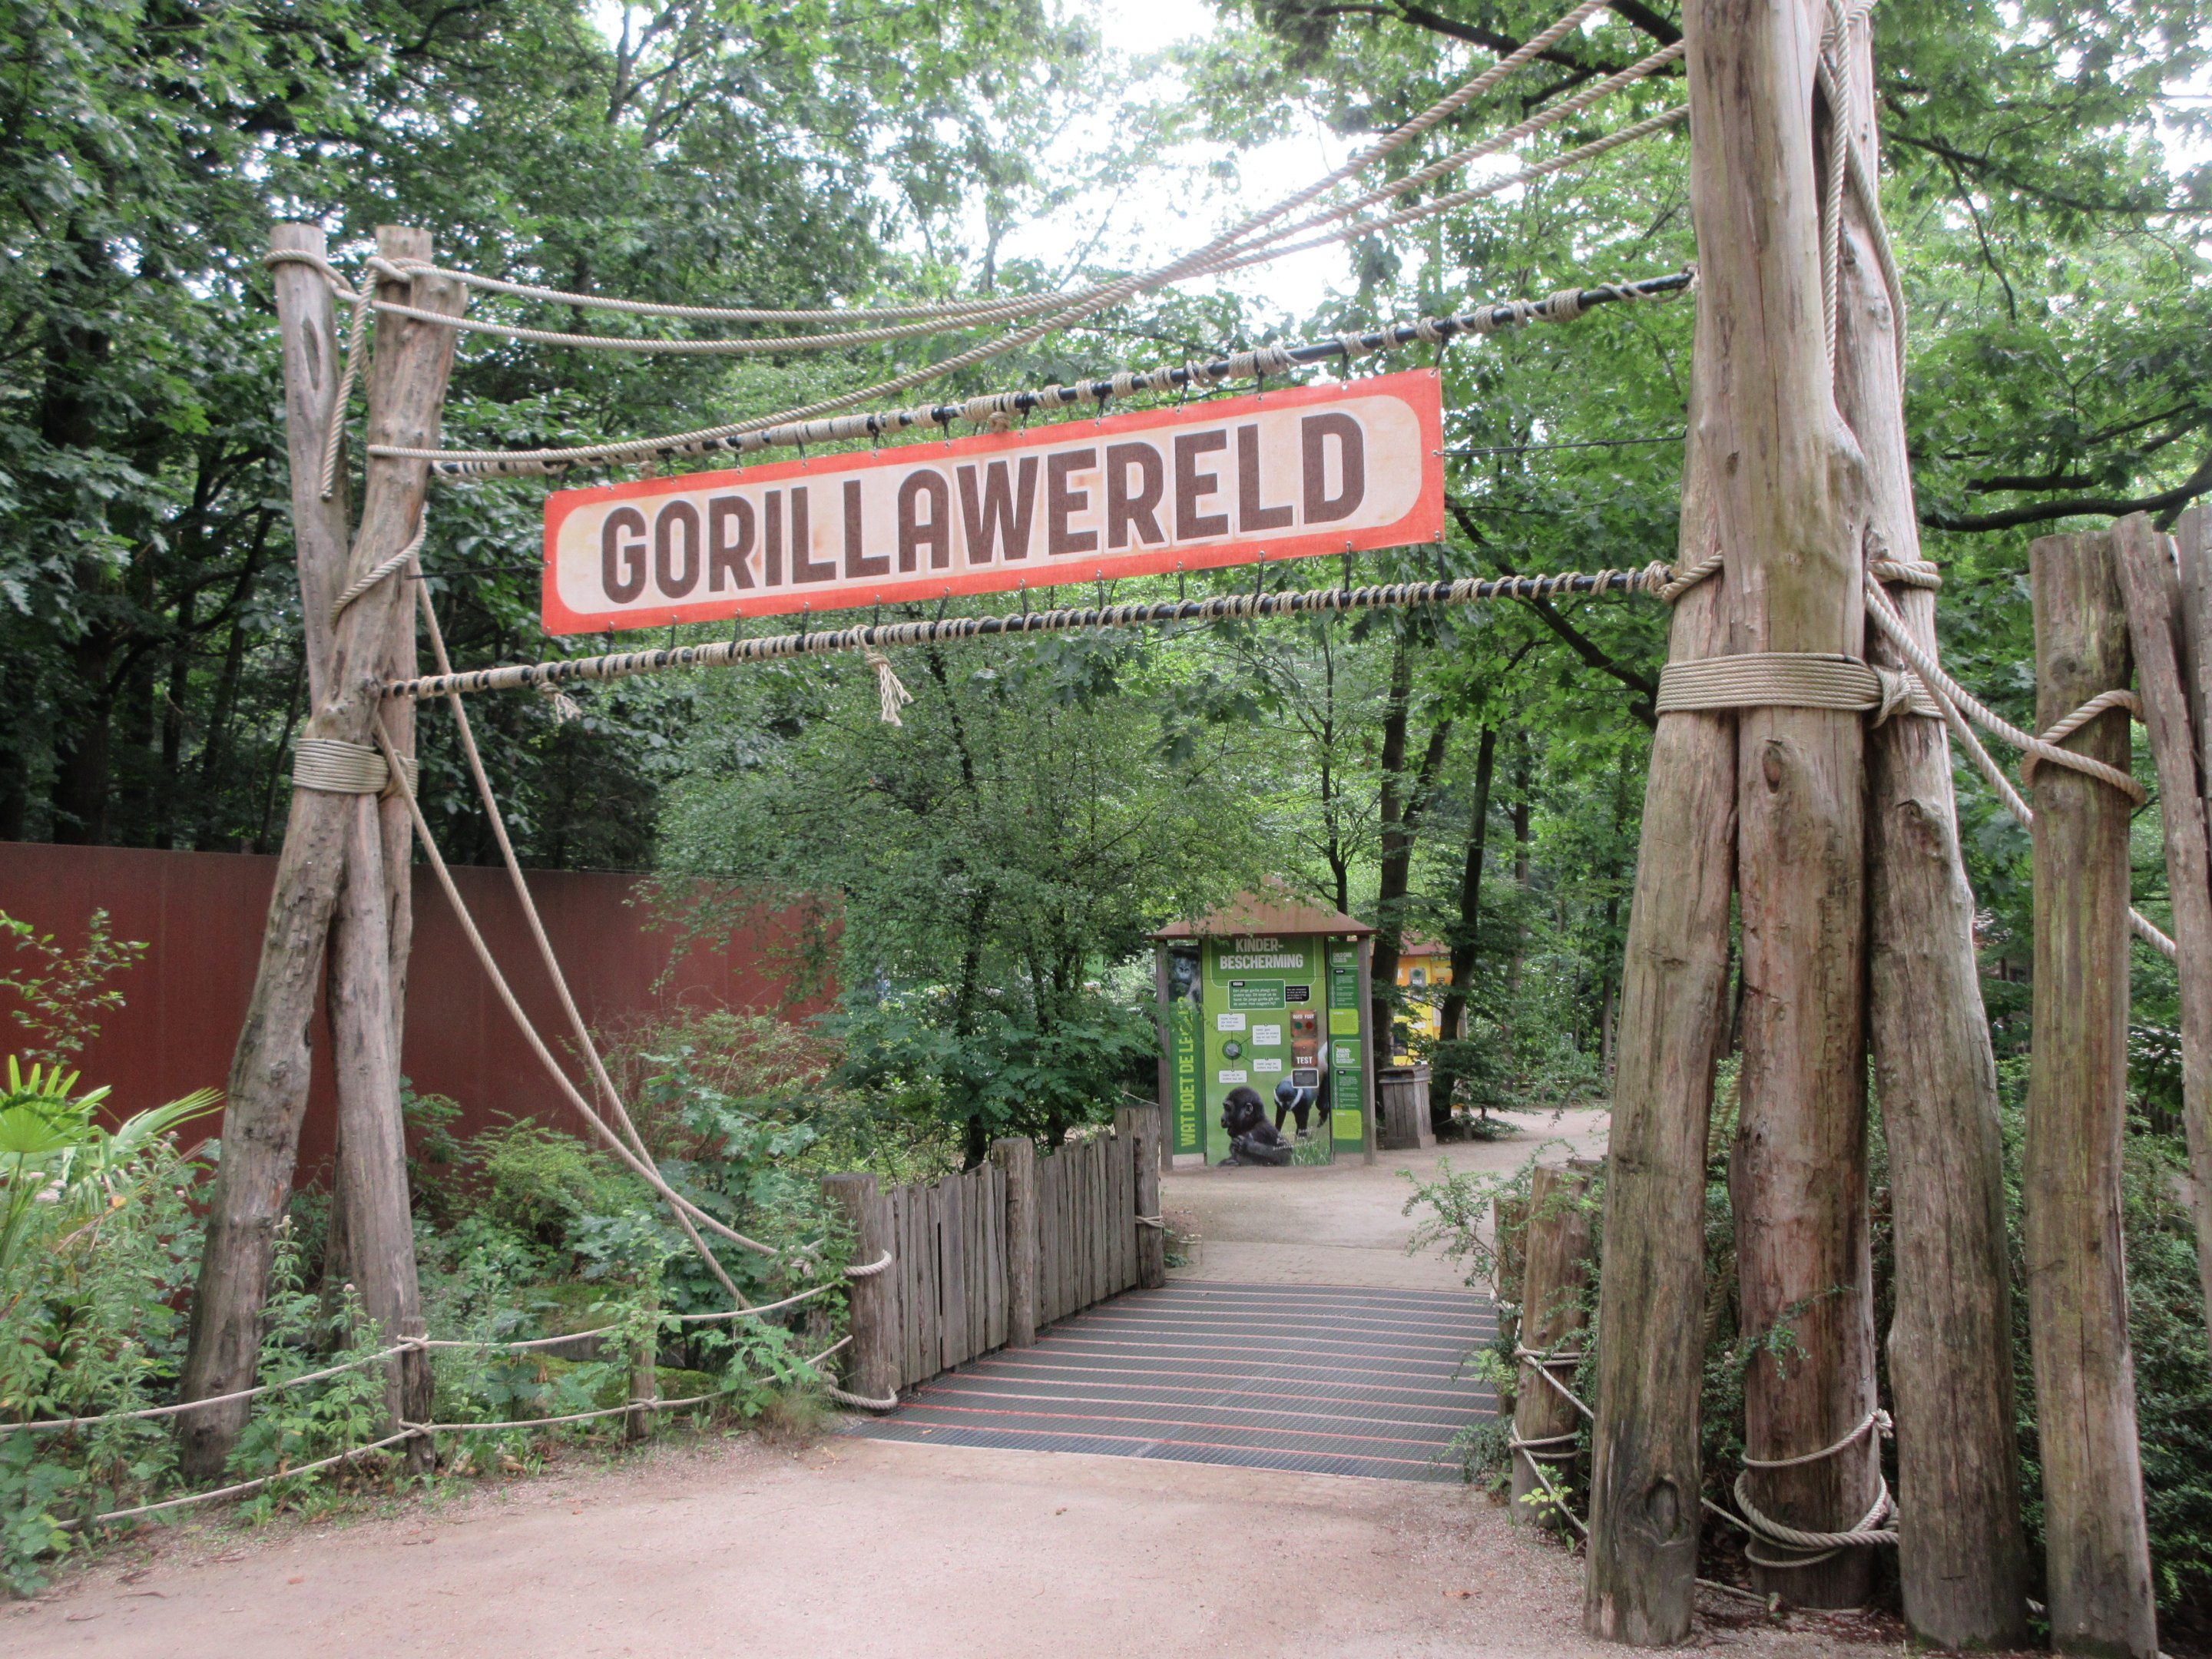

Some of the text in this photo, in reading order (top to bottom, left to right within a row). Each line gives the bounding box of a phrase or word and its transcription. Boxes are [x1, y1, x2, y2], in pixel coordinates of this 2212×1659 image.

[601, 412, 1365, 604] GORILLAWERELD
[1235, 938, 1284, 952] KINDER-
[1220, 954, 1304, 969] BESCHERMING
[1179, 1055, 1194, 1073] DE
[1296, 1056, 1313, 1065] TEST
[1180, 1077, 1195, 1112] DOET
[1181, 1114, 1196, 1147] WAT
